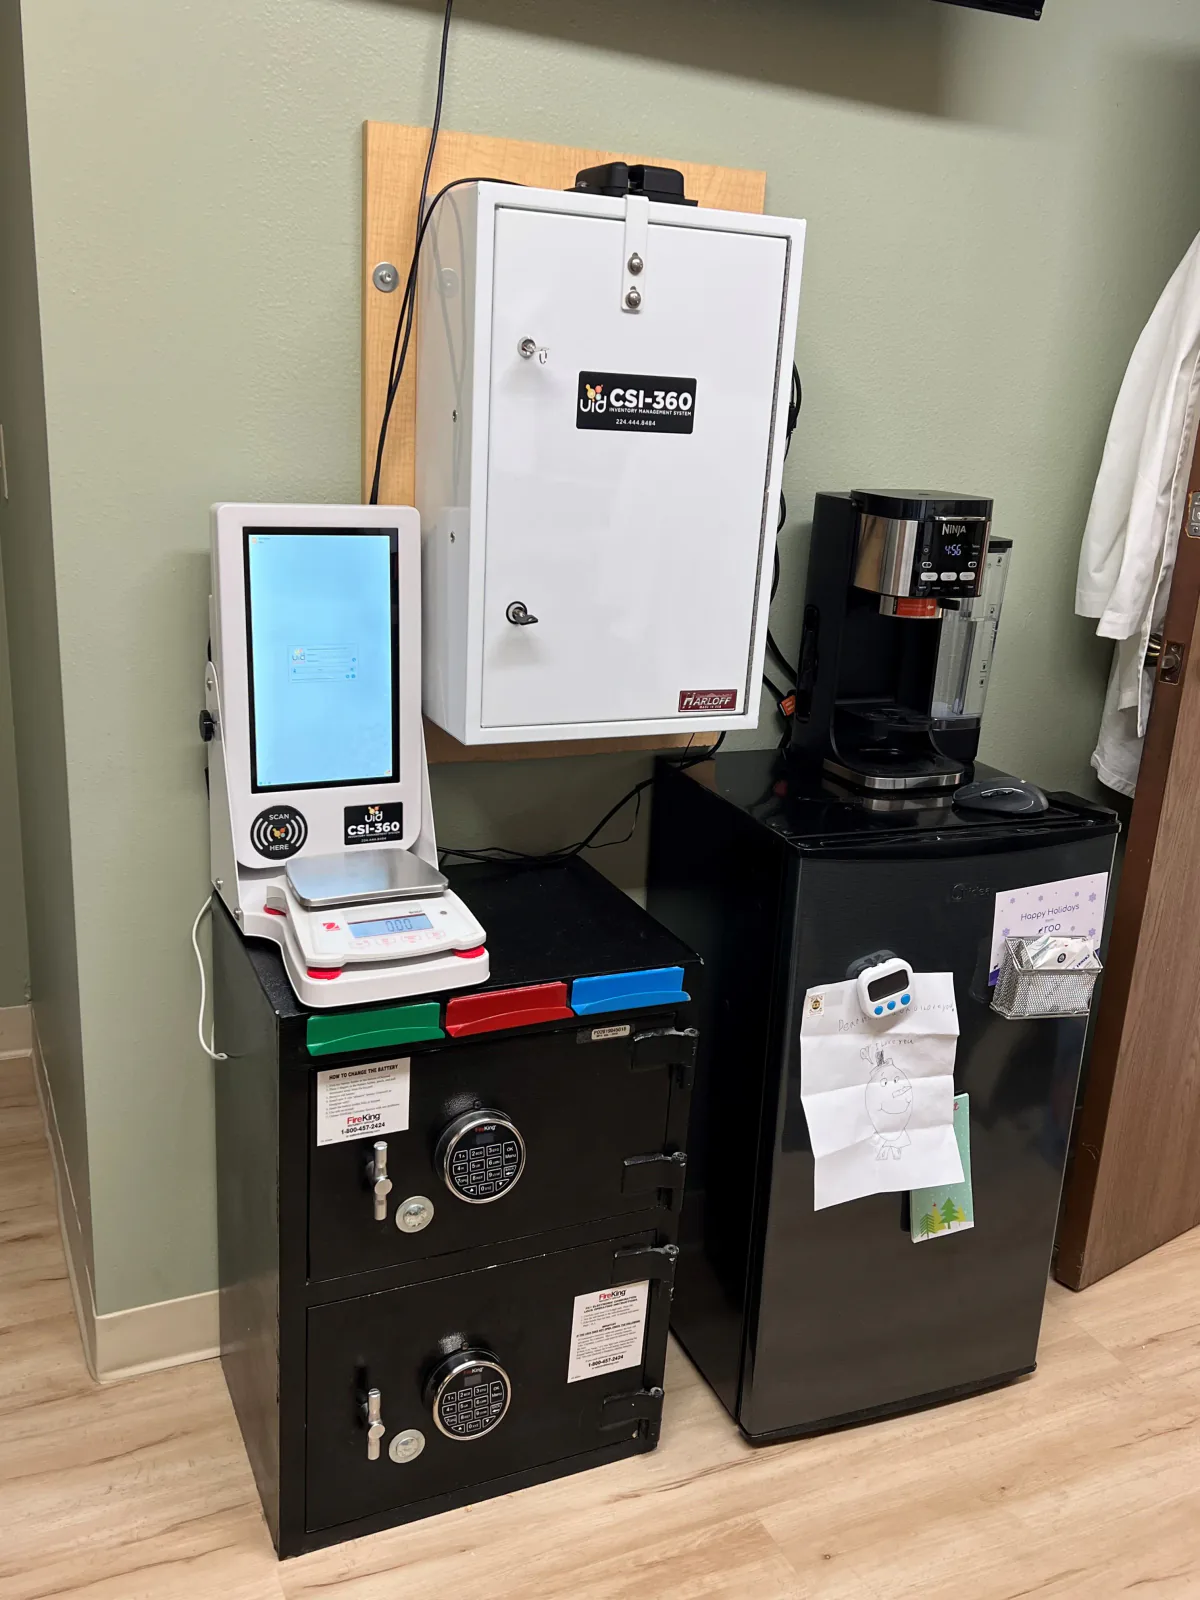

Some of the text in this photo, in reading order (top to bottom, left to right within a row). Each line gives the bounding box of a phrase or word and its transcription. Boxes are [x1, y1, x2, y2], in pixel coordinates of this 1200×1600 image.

[609, 388, 693, 411] CSI-360
[268, 813, 290, 821] SCAN
[347, 821, 400, 836] CSI-360
[269, 843, 290, 851] HERE
[1020, 904, 1080, 921] Happy Holidays
[347, 1069, 367, 1077] CHANGE
[377, 1064, 399, 1072] BATTERY
[347, 1113, 381, 1124] FireKing
[341, 1122, 386, 1134] 1-800-457-2424
